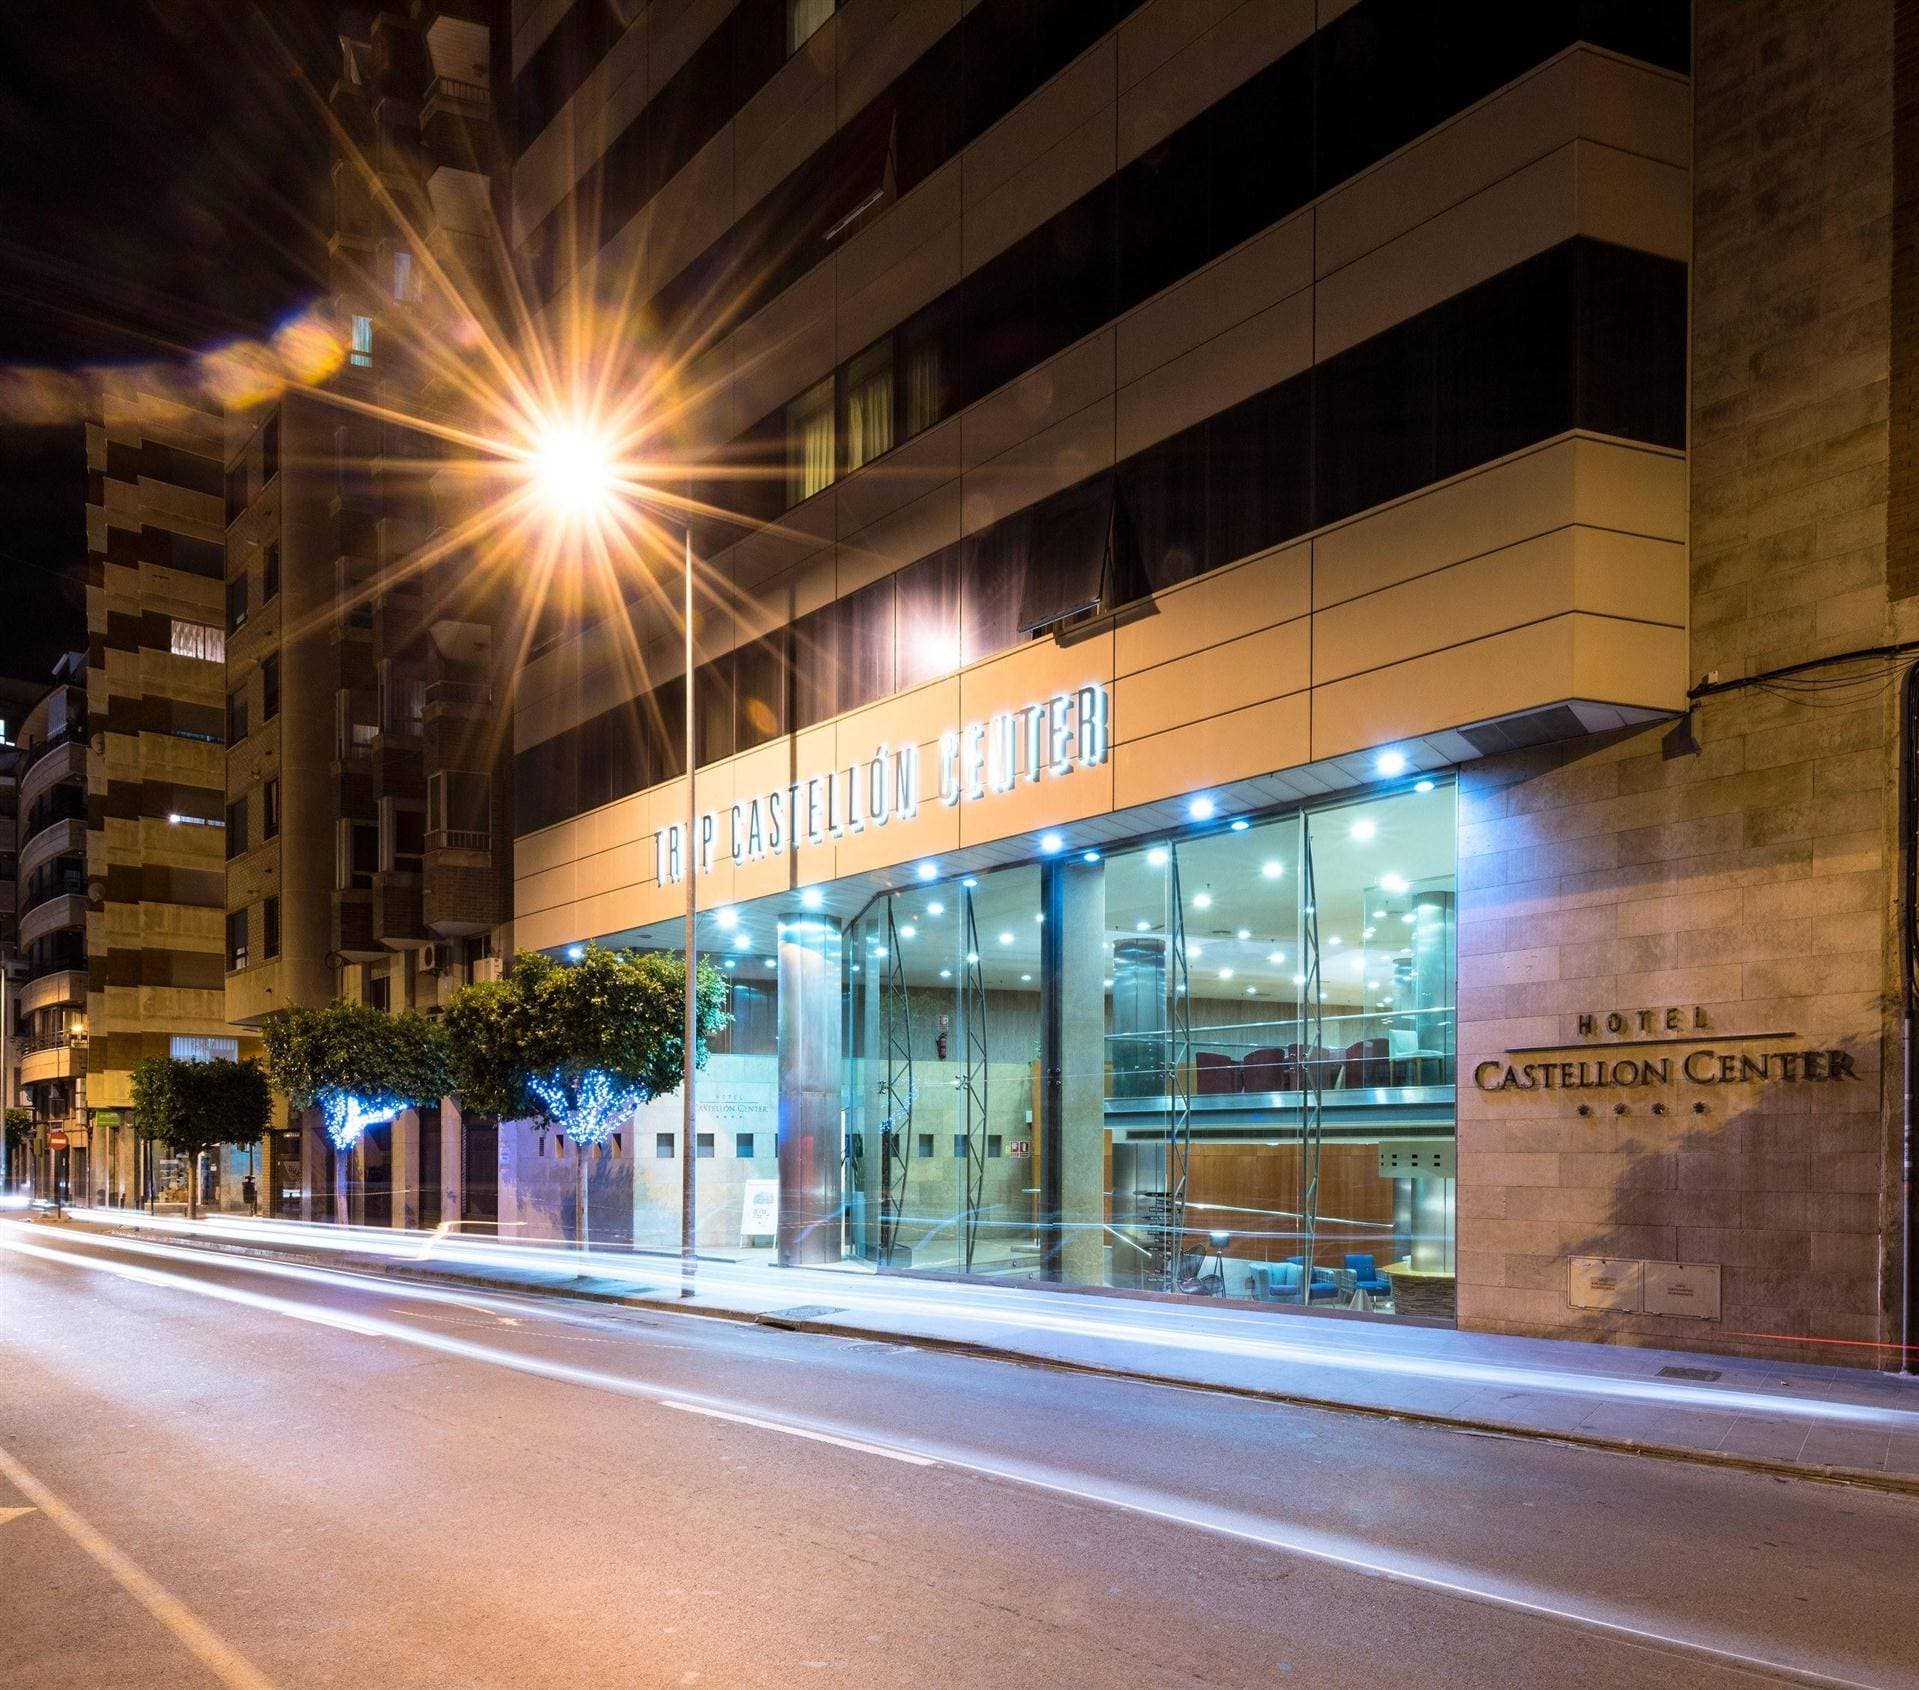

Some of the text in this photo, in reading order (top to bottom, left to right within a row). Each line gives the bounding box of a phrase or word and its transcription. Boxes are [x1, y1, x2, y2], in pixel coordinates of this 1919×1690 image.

[654, 683, 1109, 888] TRP CASTELLÓN CENTER
[1577, 1006, 1709, 1035] HOTEL
[1474, 1049, 1862, 1092] CASTELLON CENTER
[696, 1103, 769, 1114] ASTELLON CENTER
